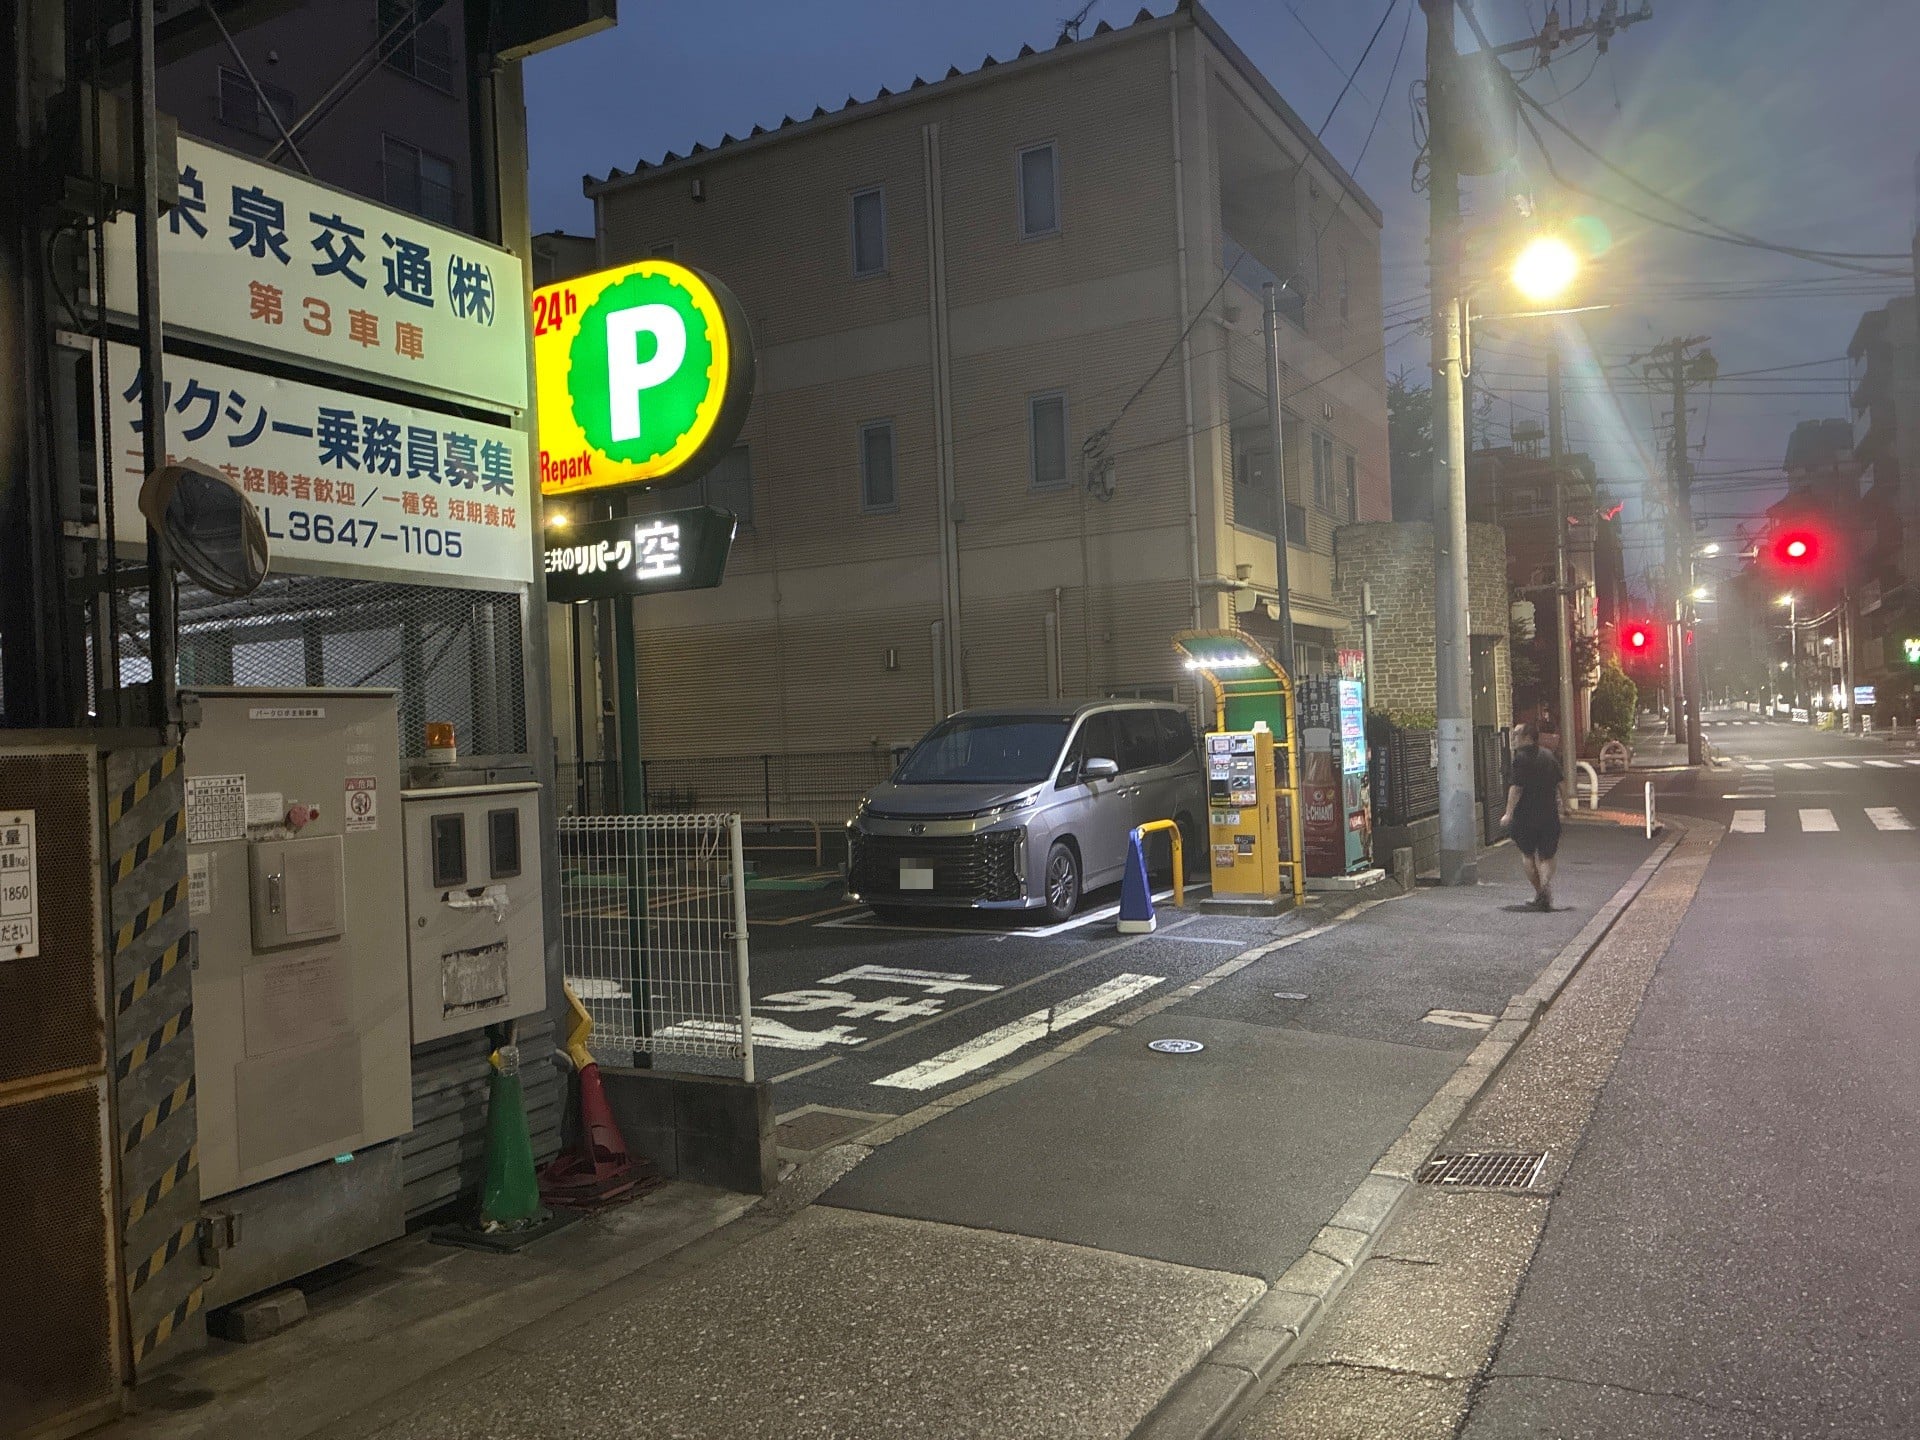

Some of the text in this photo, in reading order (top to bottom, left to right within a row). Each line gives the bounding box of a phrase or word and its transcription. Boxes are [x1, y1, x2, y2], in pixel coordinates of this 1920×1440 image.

[248, 279, 425, 361] 第3車庫
[533, 289, 577, 337] 24h
[606, 303, 687, 443] P
[540, 450, 592, 485] Repark
[448, 500, 517, 530] 短期養成
[544, 540, 632, 575] 三井のリパーク
[634, 520, 682, 580] 空
[3, 885, 29, 901] 1850
